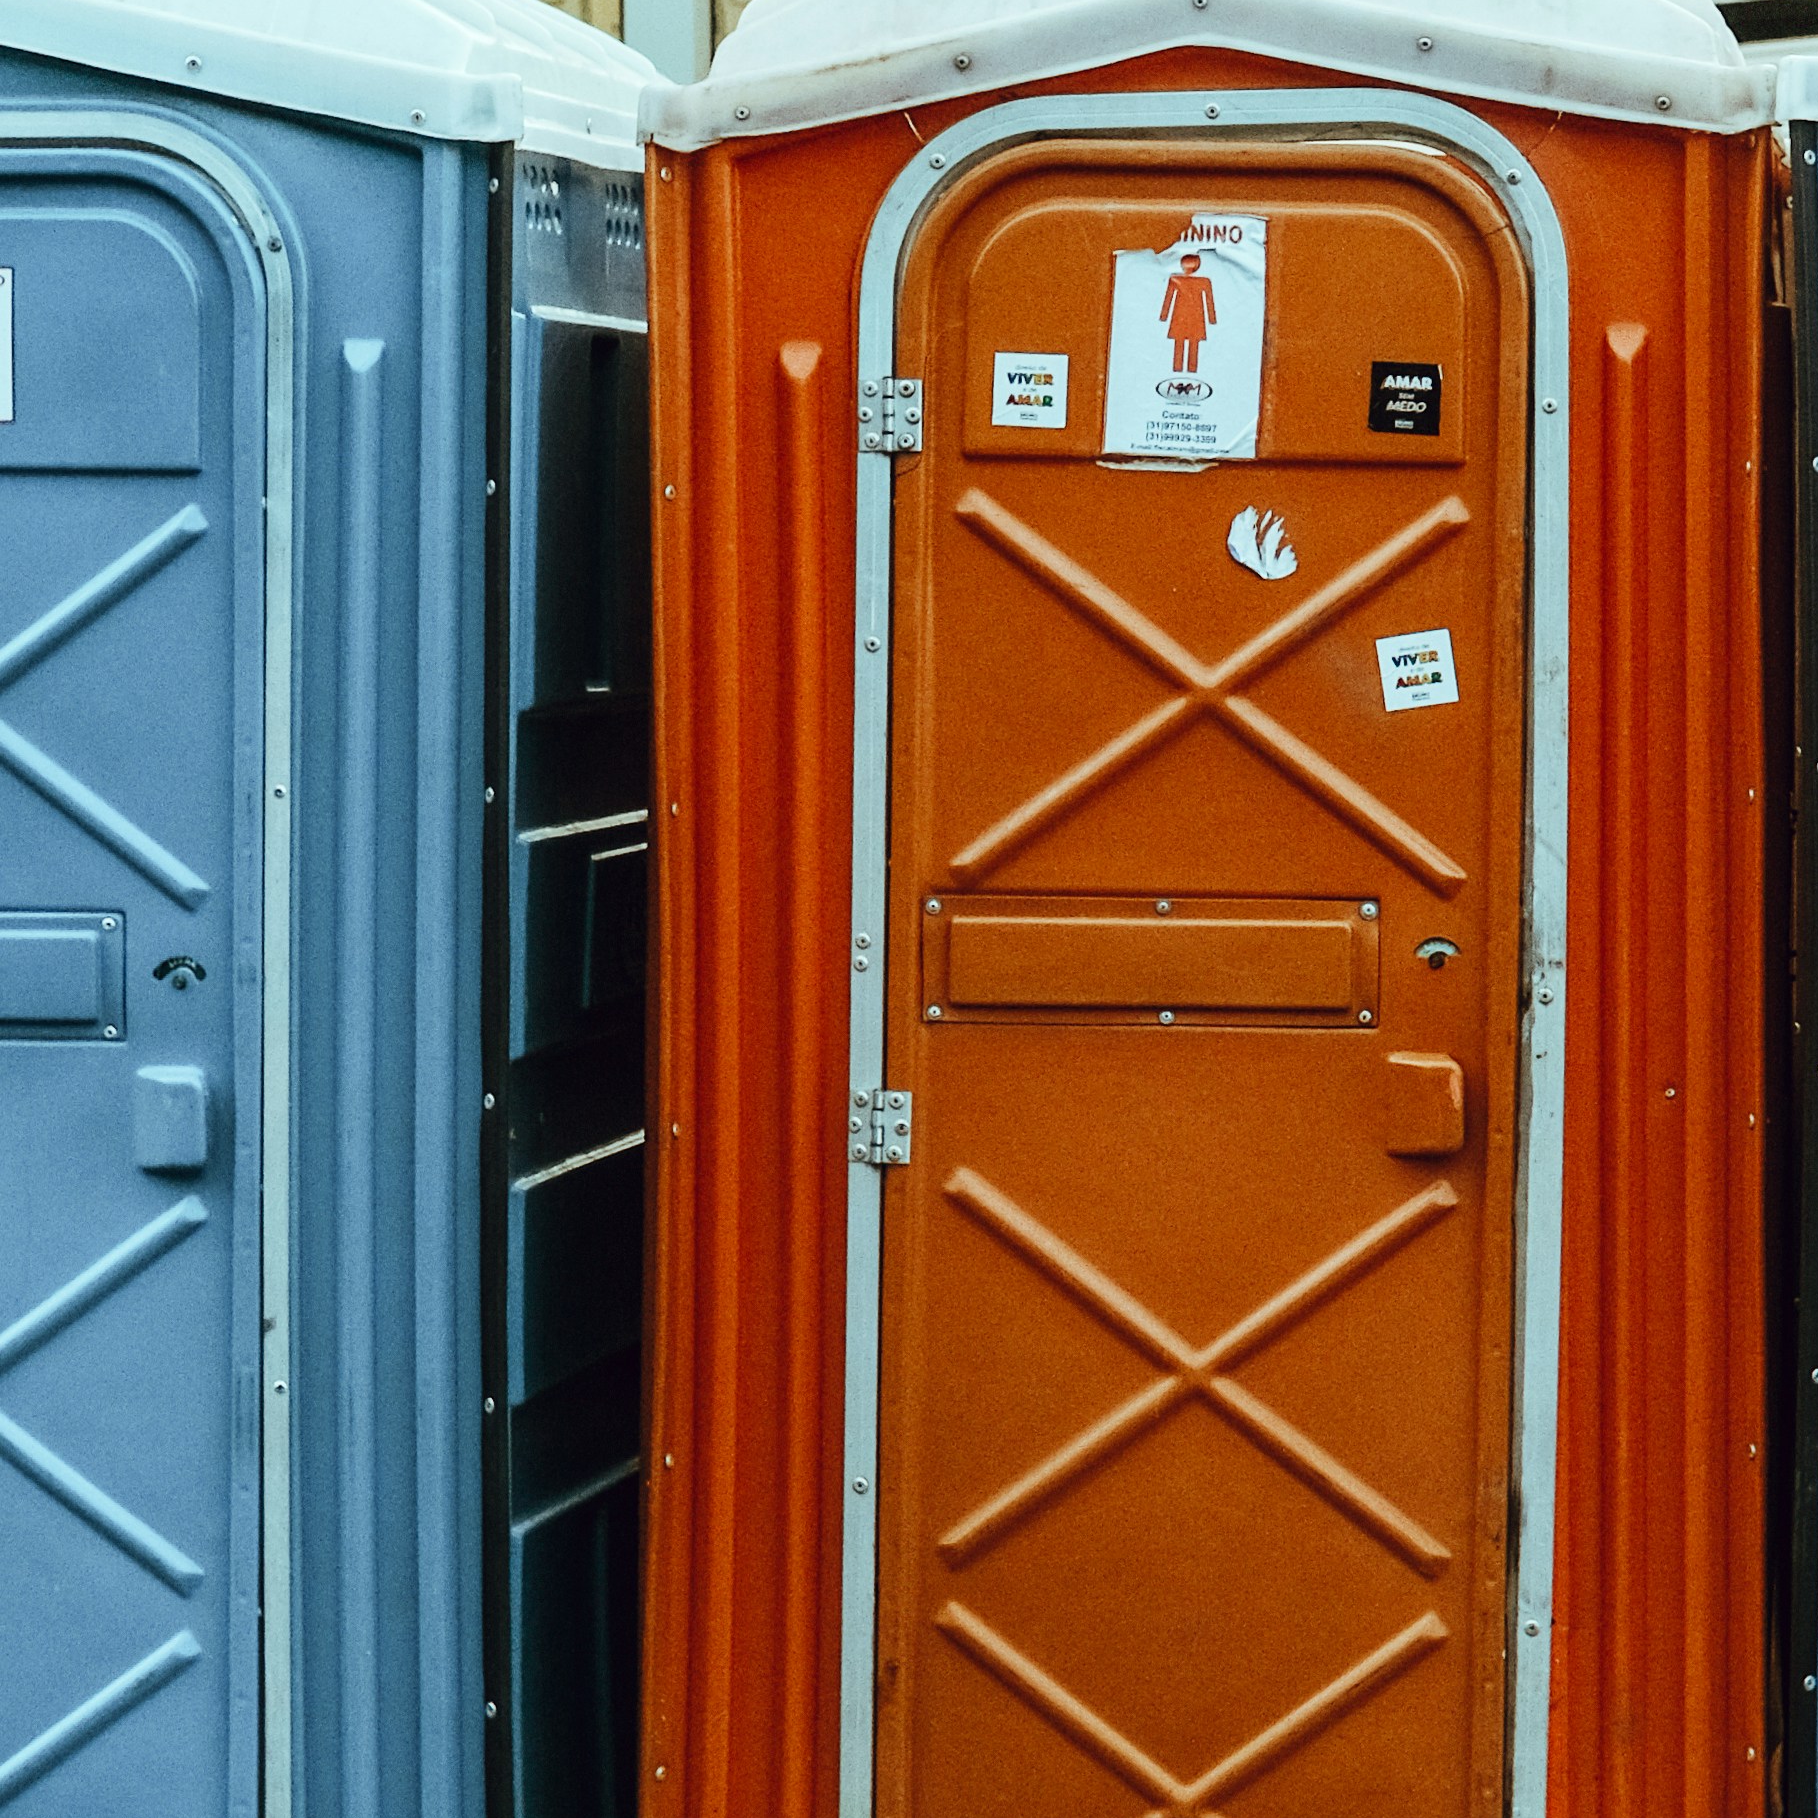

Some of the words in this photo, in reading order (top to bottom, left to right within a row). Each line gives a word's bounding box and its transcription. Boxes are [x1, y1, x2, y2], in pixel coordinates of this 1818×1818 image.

[1007, 372, 1054, 386] VIVER
[1380, 374, 1433, 392] AMAR
[1006, 393, 1054, 408] AMAR
[1385, 400, 1428, 413] MEDO
[1391, 650, 1439, 668] VIVER
[1395, 671, 1443, 690] AMAR
